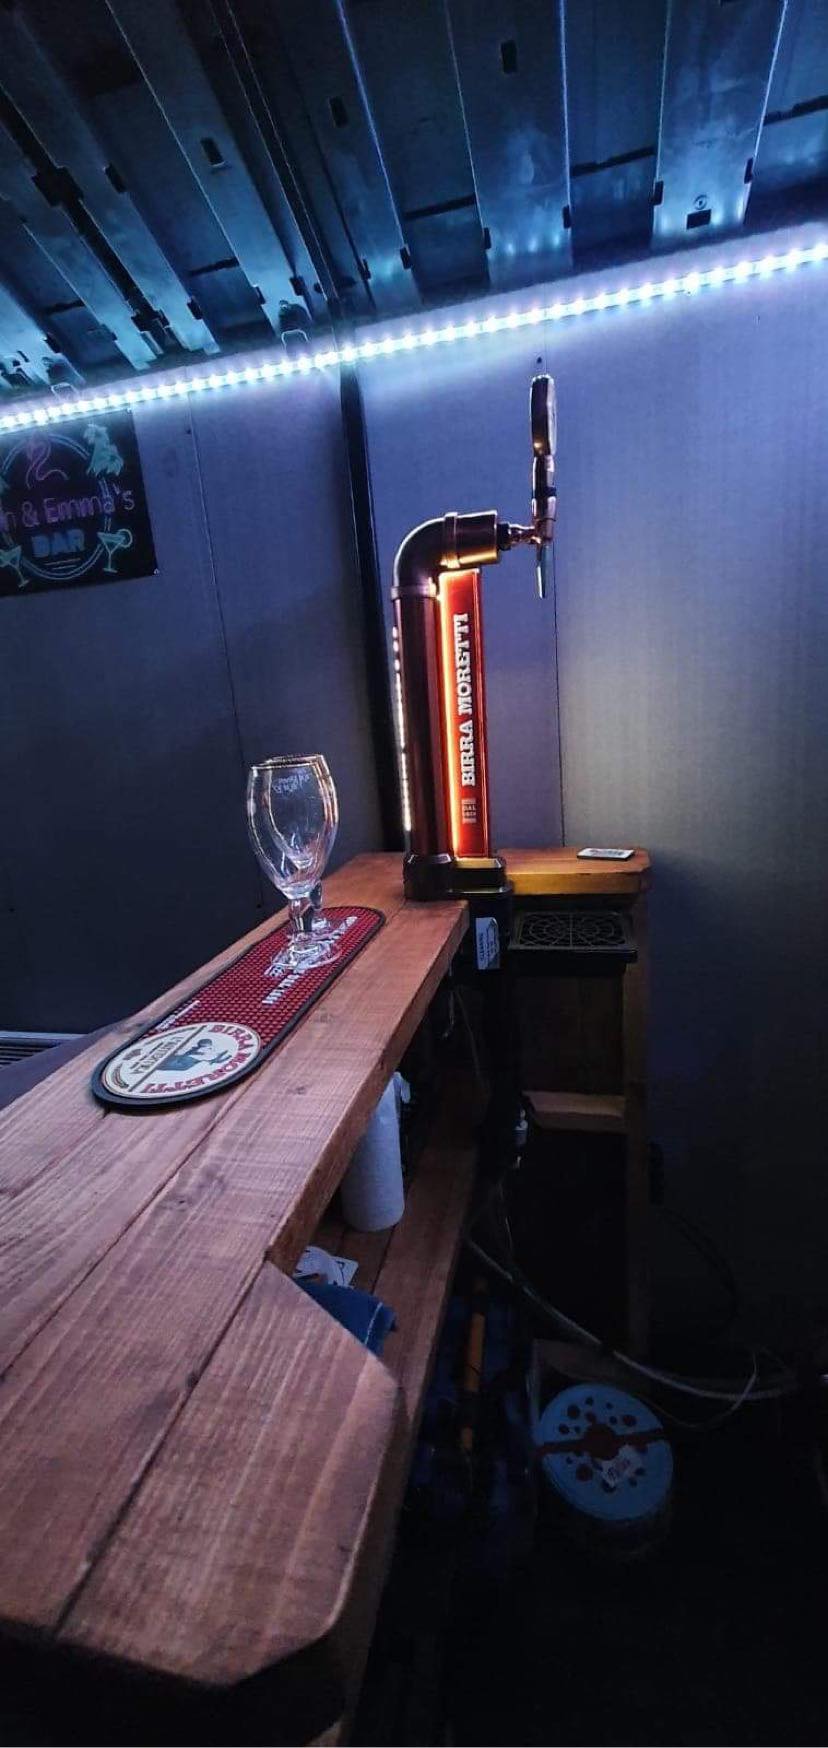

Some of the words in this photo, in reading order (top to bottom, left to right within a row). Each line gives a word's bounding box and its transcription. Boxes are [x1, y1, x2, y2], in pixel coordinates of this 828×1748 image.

[22, 501, 40, 528] &
[44, 483, 135, 523] Emma's
[453, 613, 473, 716] MORETTI
[459, 719, 476, 787] BIRRA
[208, 1024, 253, 1051] BIRRA
[141, 1052, 251, 1094] MORETTI
